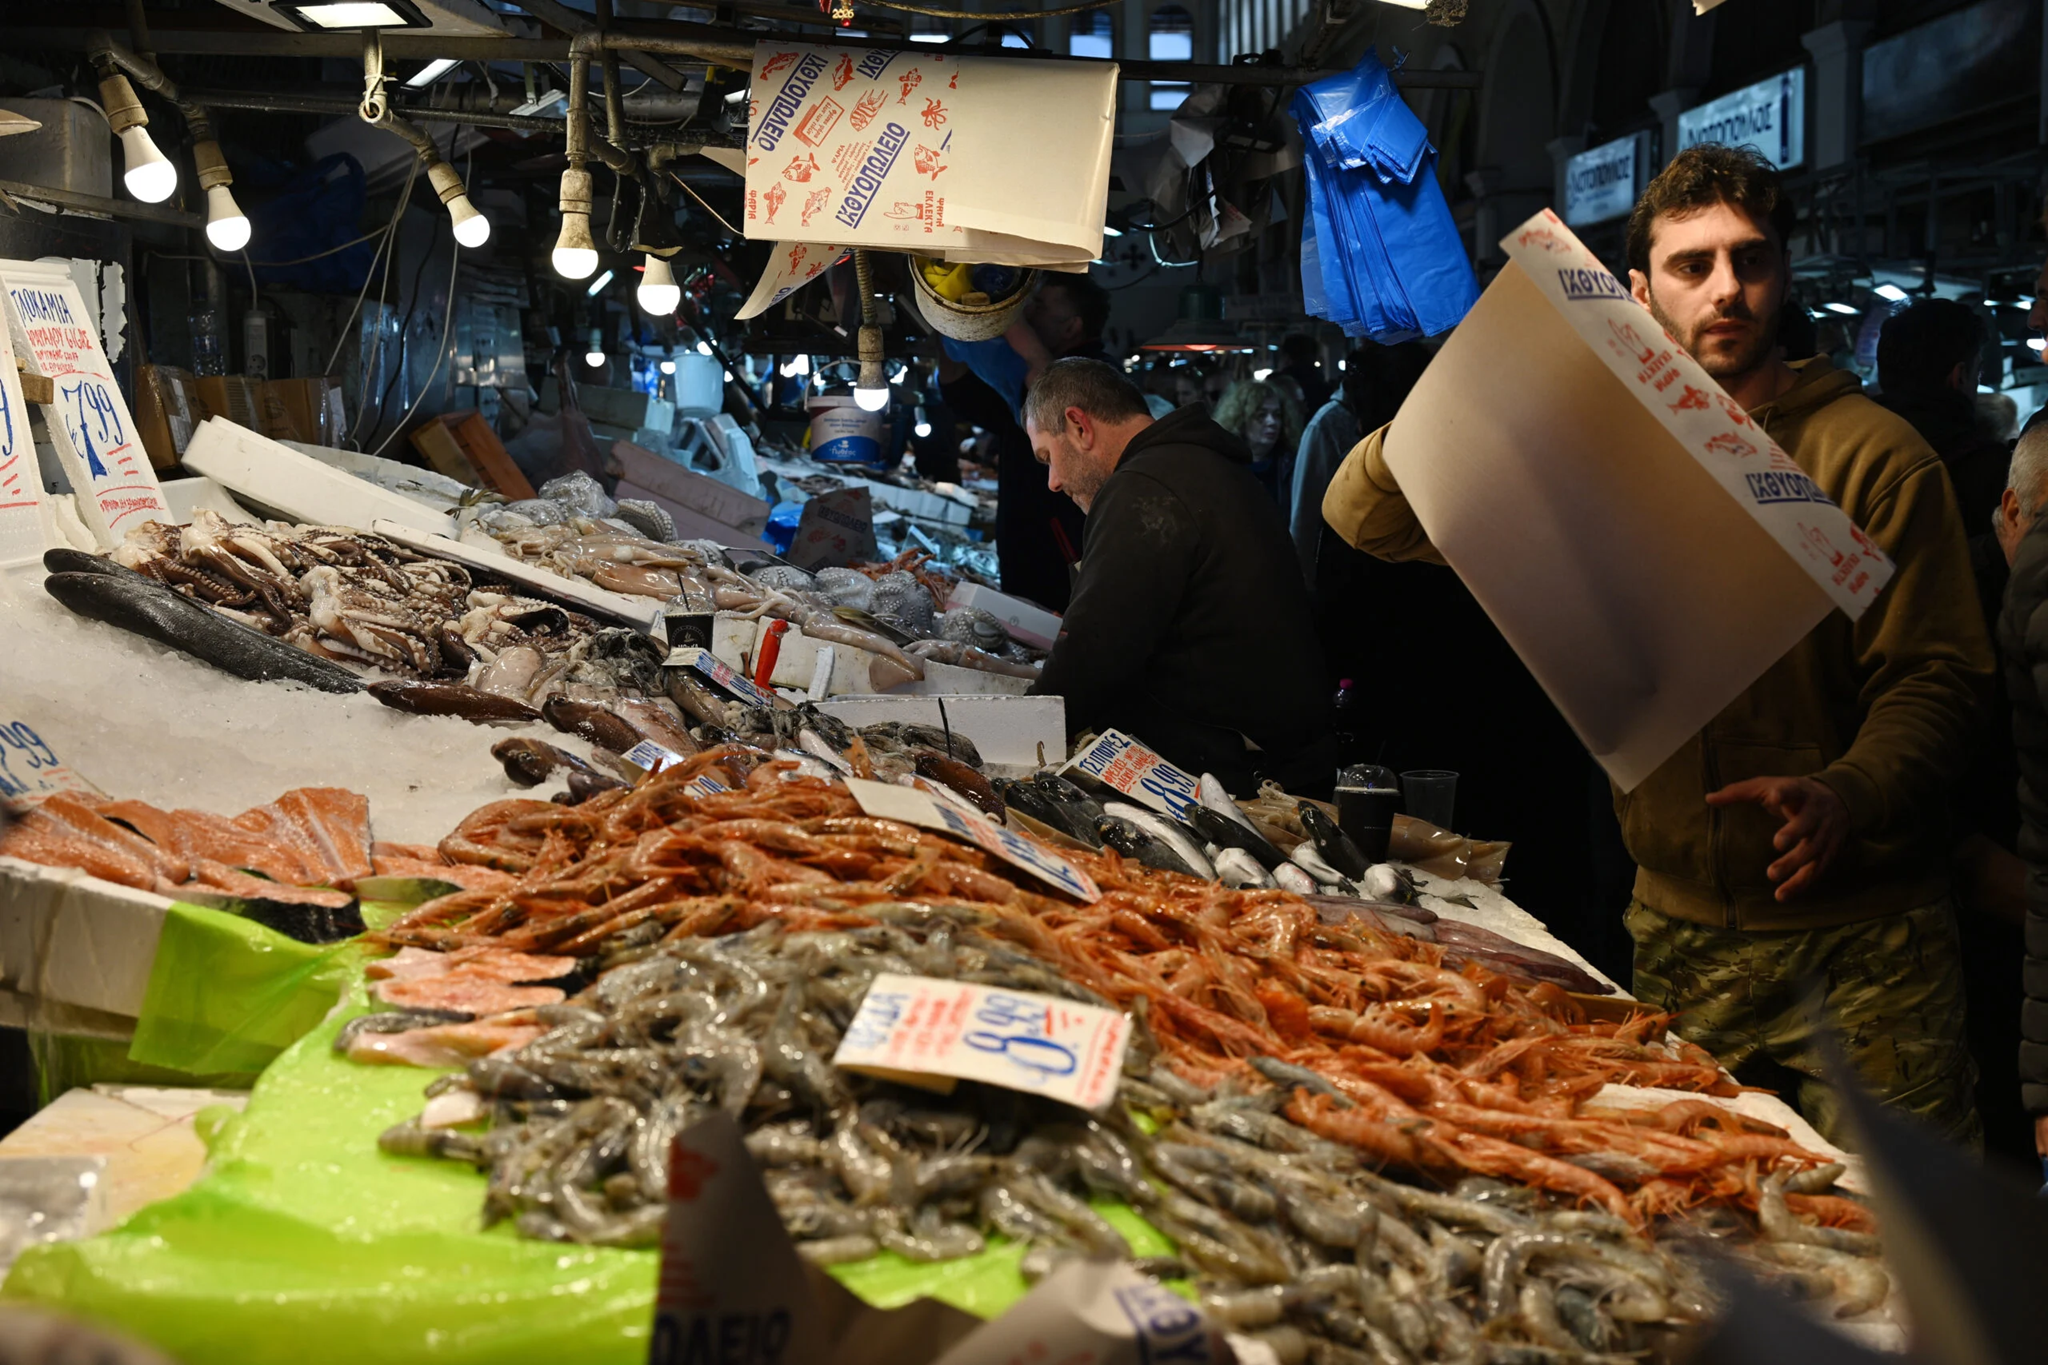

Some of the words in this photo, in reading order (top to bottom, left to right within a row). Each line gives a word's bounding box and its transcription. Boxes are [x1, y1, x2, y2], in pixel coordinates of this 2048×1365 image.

[756, 53, 829, 152] ΙΧΘΥΟΠΩΛΕΙΟ
[836, 122, 906, 228] ΙΧΘΥΟΠΩΛΕΙΟ
[748, 189, 757, 220] ΨΑΡΙΑ
[924, 190, 933, 234] ΕΚΛΕΚΤΑ
[1079, 732, 1131, 777] ΤΣΙΠΟΥΡΕΣ
